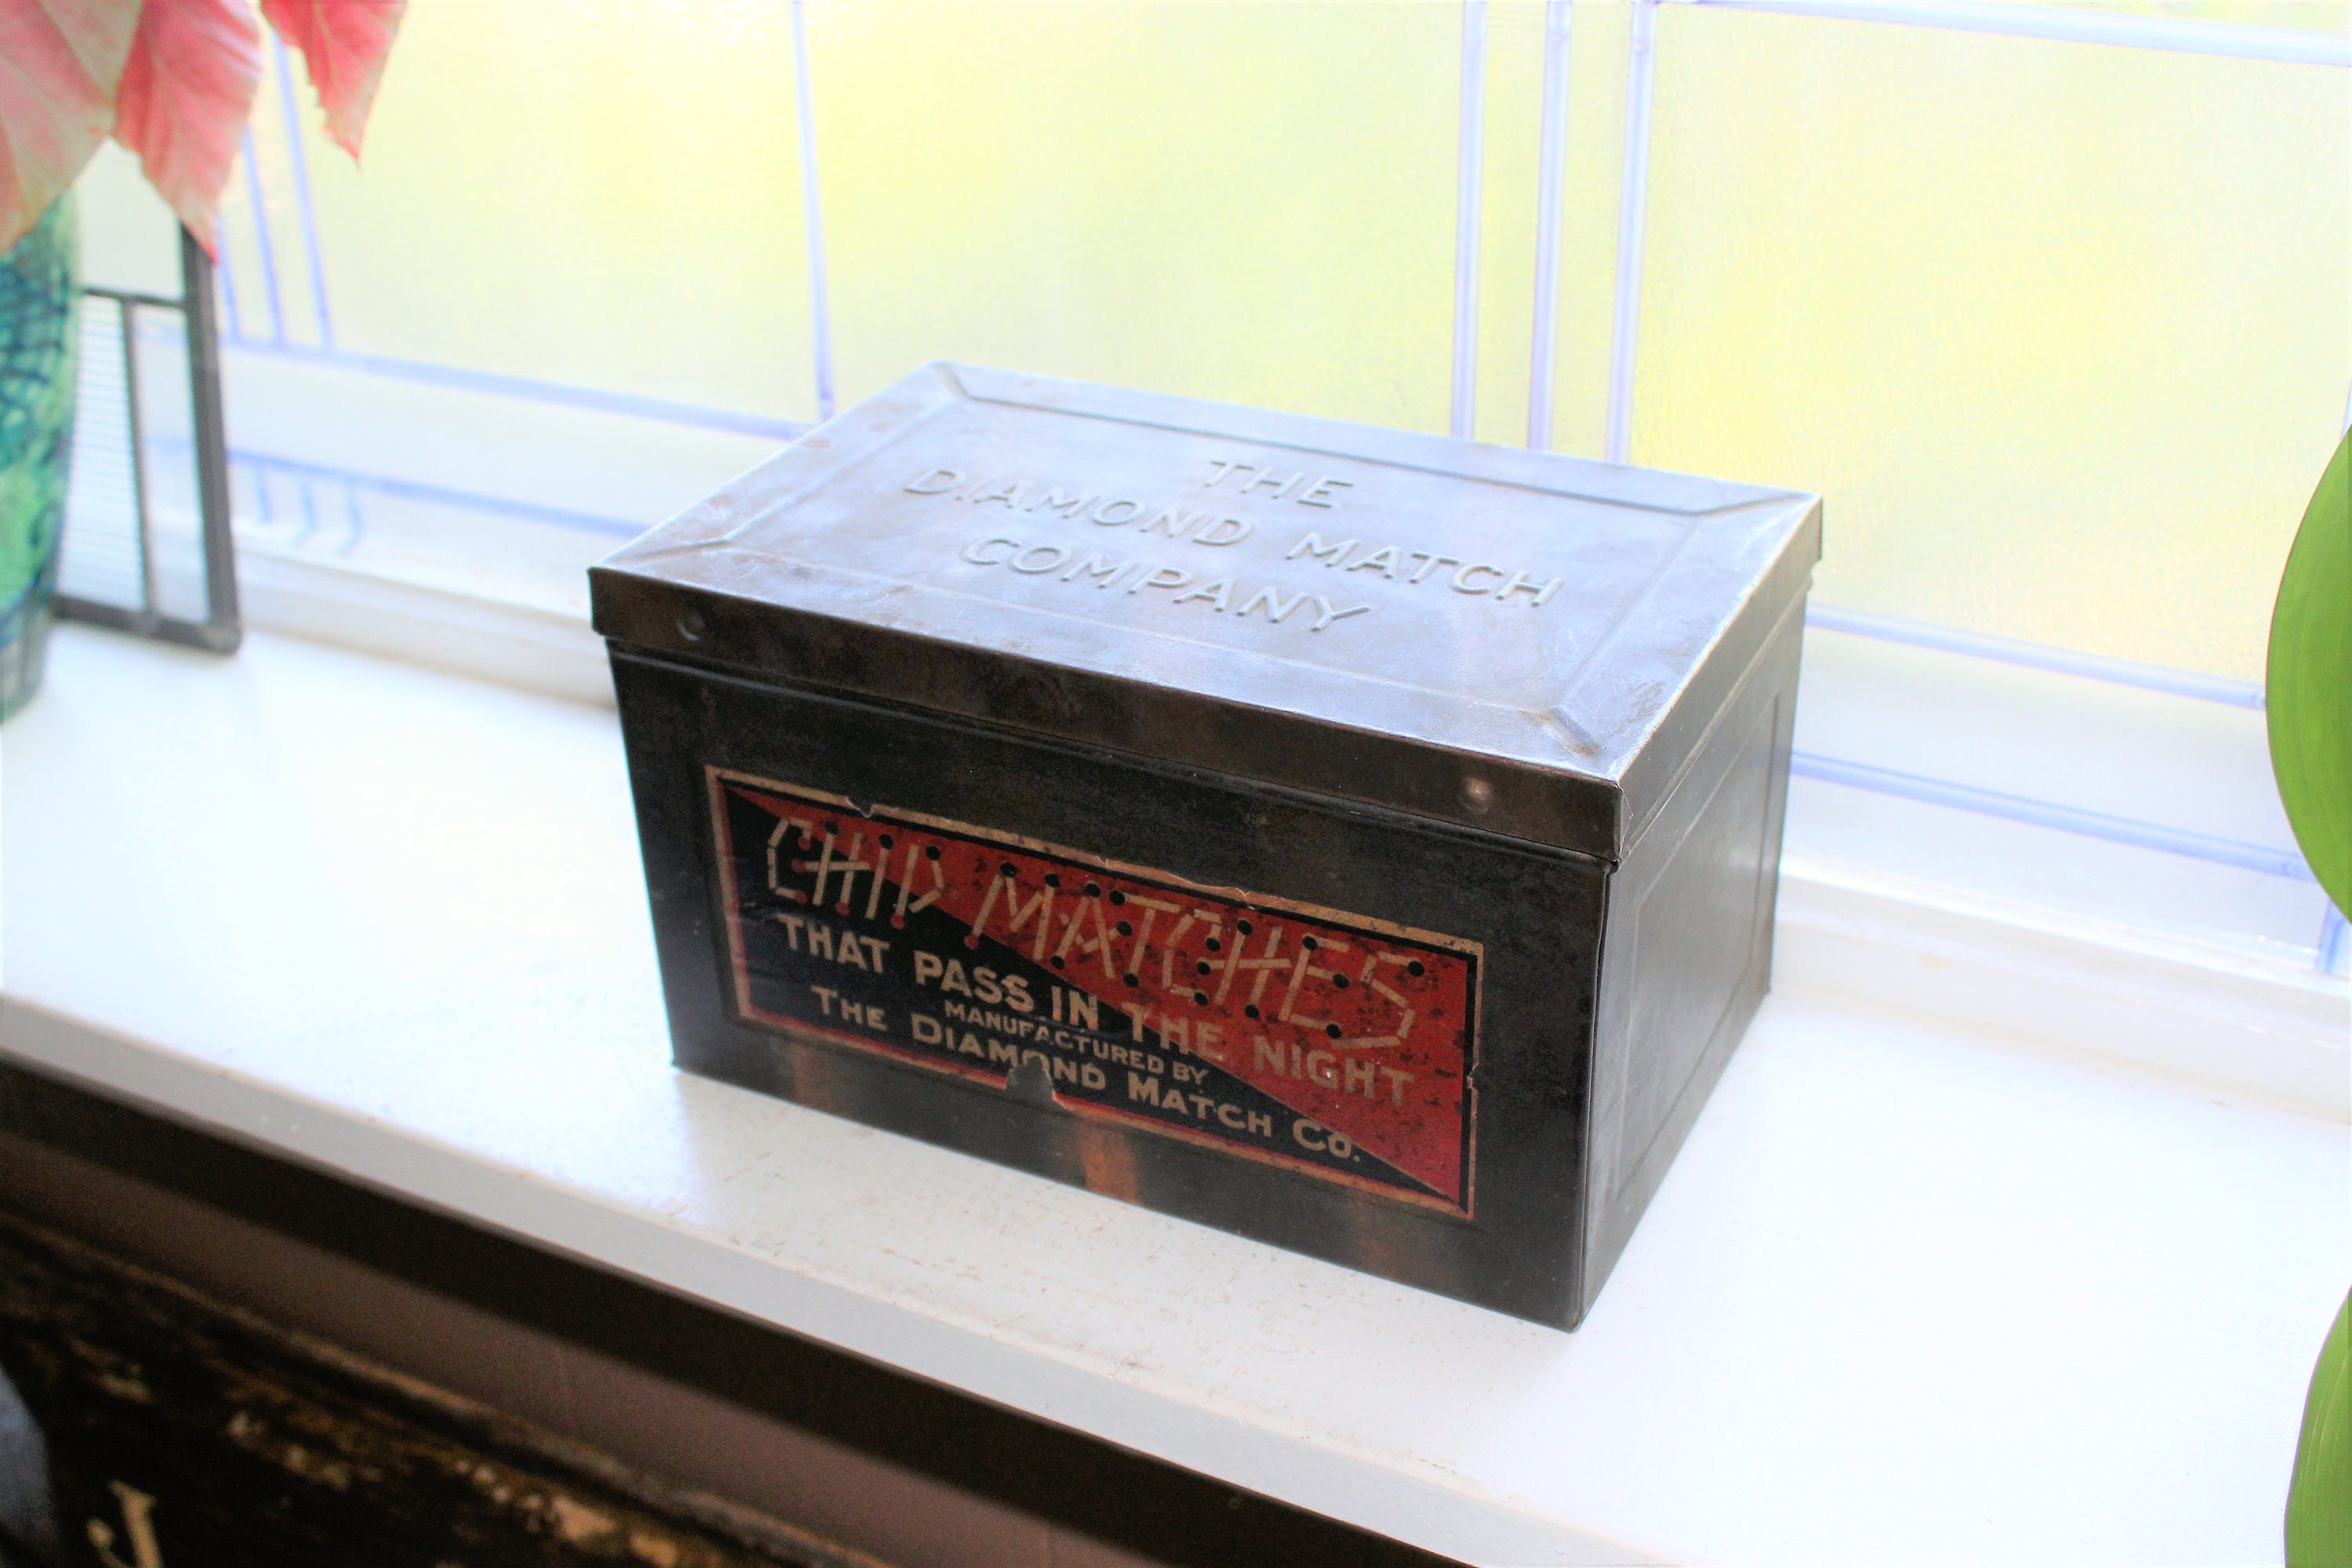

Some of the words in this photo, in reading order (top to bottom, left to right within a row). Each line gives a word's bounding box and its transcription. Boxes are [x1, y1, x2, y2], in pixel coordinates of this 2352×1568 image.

[903, 468, 1253, 547] DIAMOND
[1286, 531, 1563, 608] MATCH
[1200, 460, 1354, 509] THE
[963, 538, 1373, 633] COMPANY
[775, 913, 891, 974] THAT
[913, 950, 1035, 1013] PASS
[1051, 986, 1098, 1030] IN
[1121, 1001, 1228, 1062] THE
[1254, 1035, 1415, 1106] NIGHT
[964, 862, 1425, 1051] MATCHES
[811, 986, 887, 1031] THE
[1128, 1073, 1272, 1138] MATCH
[944, 1000, 1165, 1076] MANUFACTURED
[1173, 1062, 1210, 1086] BY
